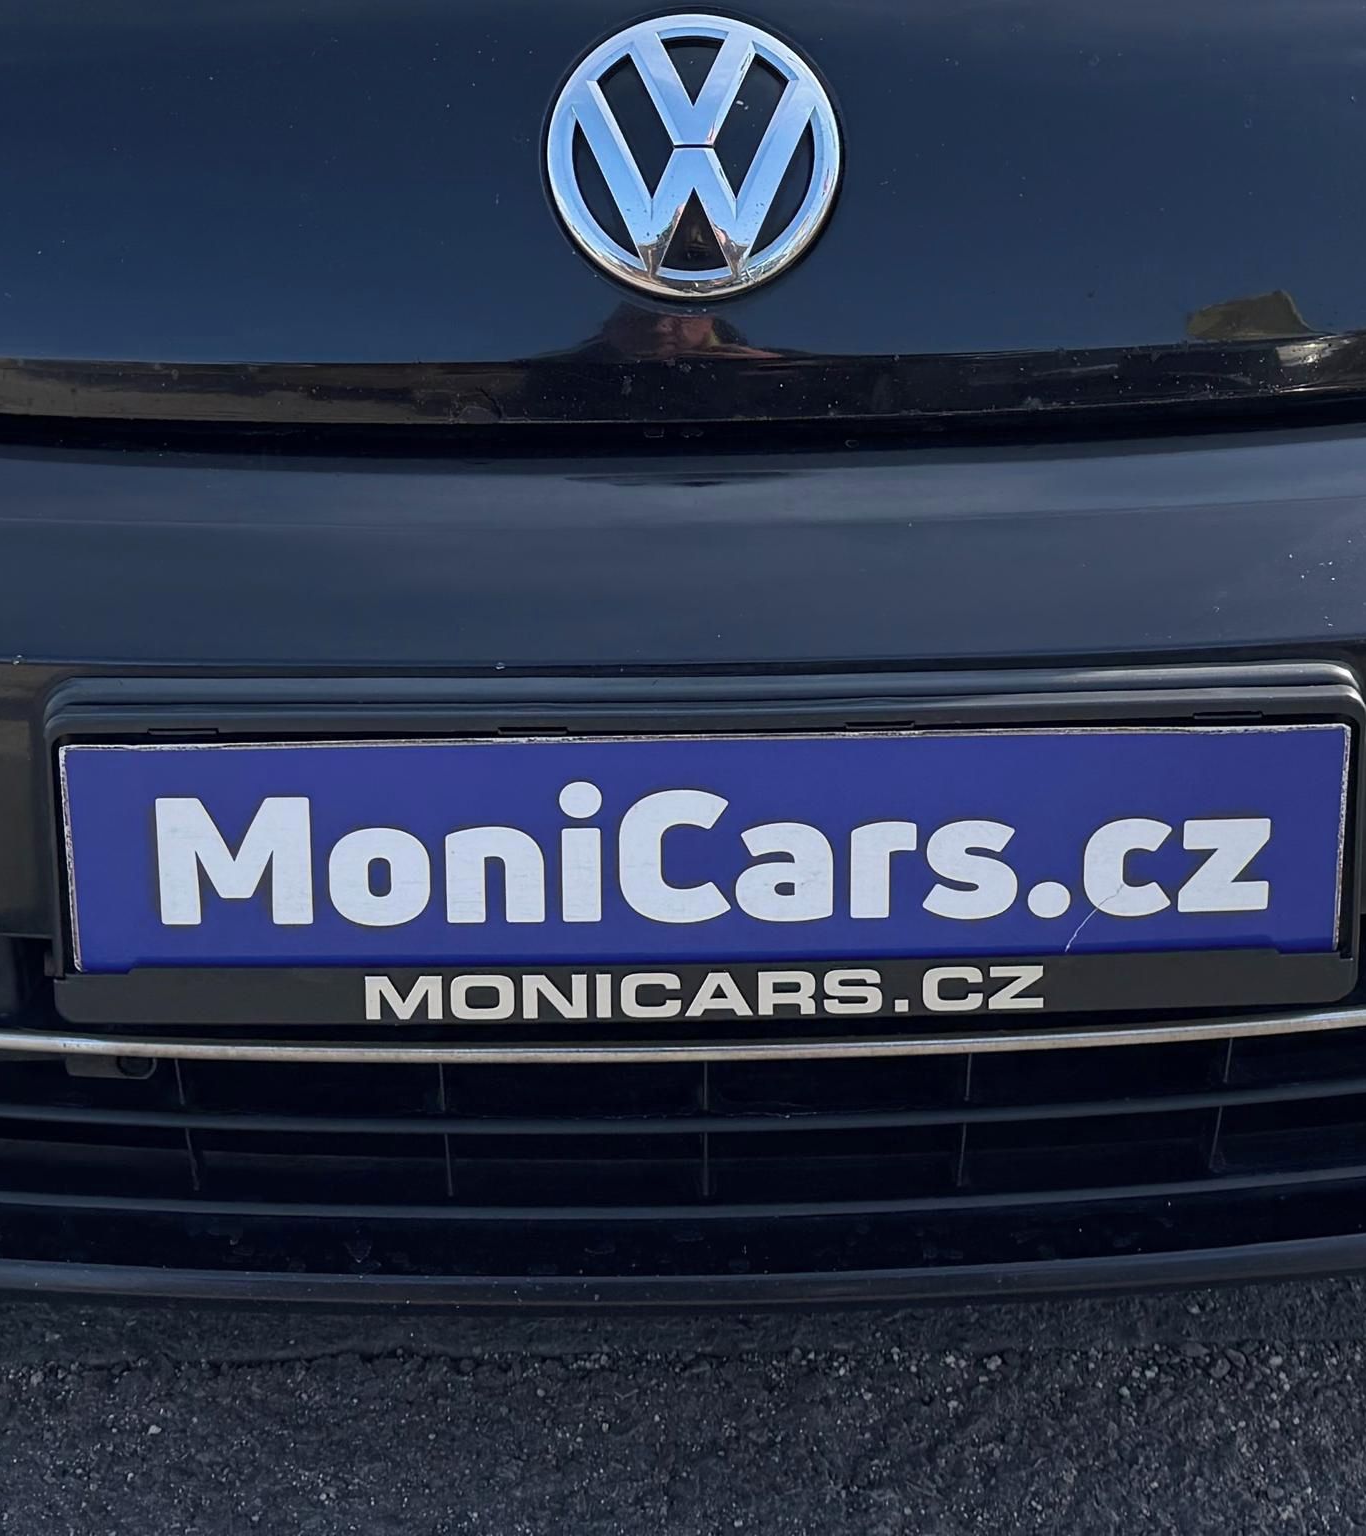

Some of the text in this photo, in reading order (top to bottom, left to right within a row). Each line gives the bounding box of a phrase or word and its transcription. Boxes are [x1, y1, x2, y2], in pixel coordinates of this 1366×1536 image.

[549, 14, 839, 296] VW
[154, 782, 1271, 927] MoniCars.cz
[363, 966, 1045, 1020] MONICARS.CZ
